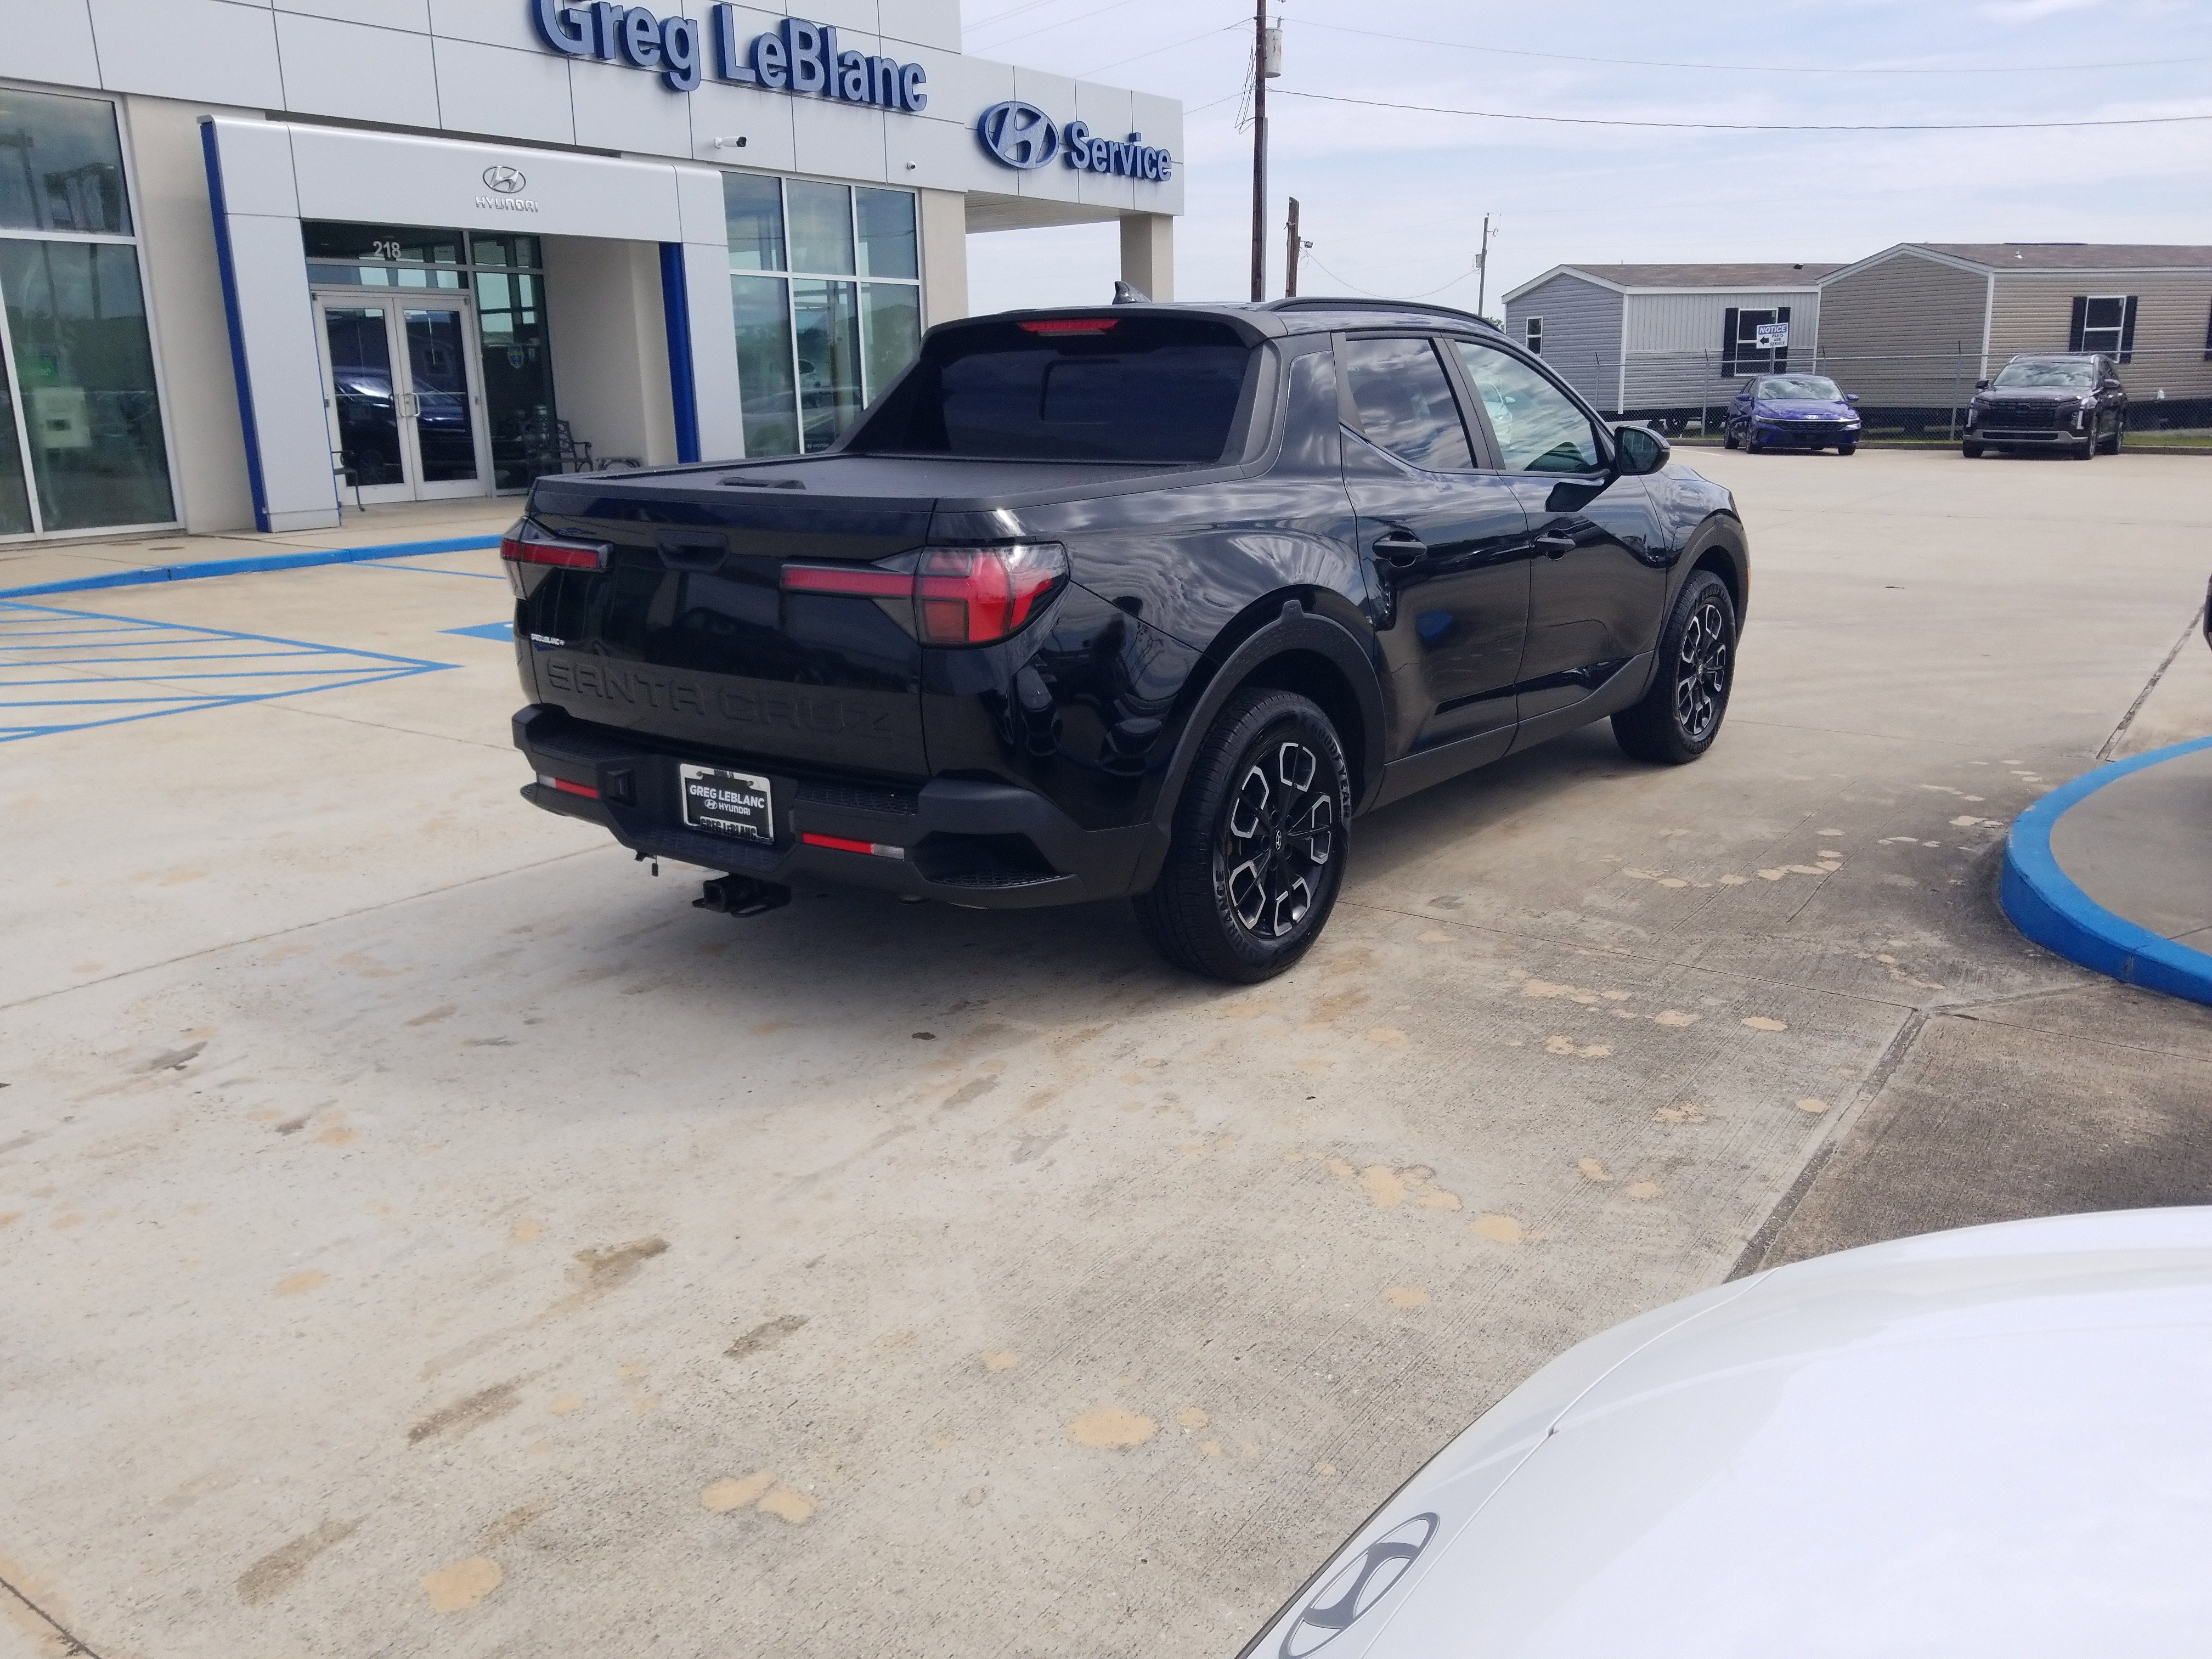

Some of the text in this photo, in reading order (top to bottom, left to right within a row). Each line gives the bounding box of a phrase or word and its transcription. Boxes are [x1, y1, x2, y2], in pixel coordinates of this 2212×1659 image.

[533, 0, 927, 111] Greg LeBlanc
[1064, 121, 1171, 181] Service
[475, 196, 538, 212] HYUNDAI
[373, 241, 402, 258] 218
[1759, 325, 1786, 334] NOTICE
[547, 657, 894, 740] SANTA CRUZ
[690, 785, 765, 809] GREG LEBLANC
[719, 802, 751, 816] HYUNDAI
